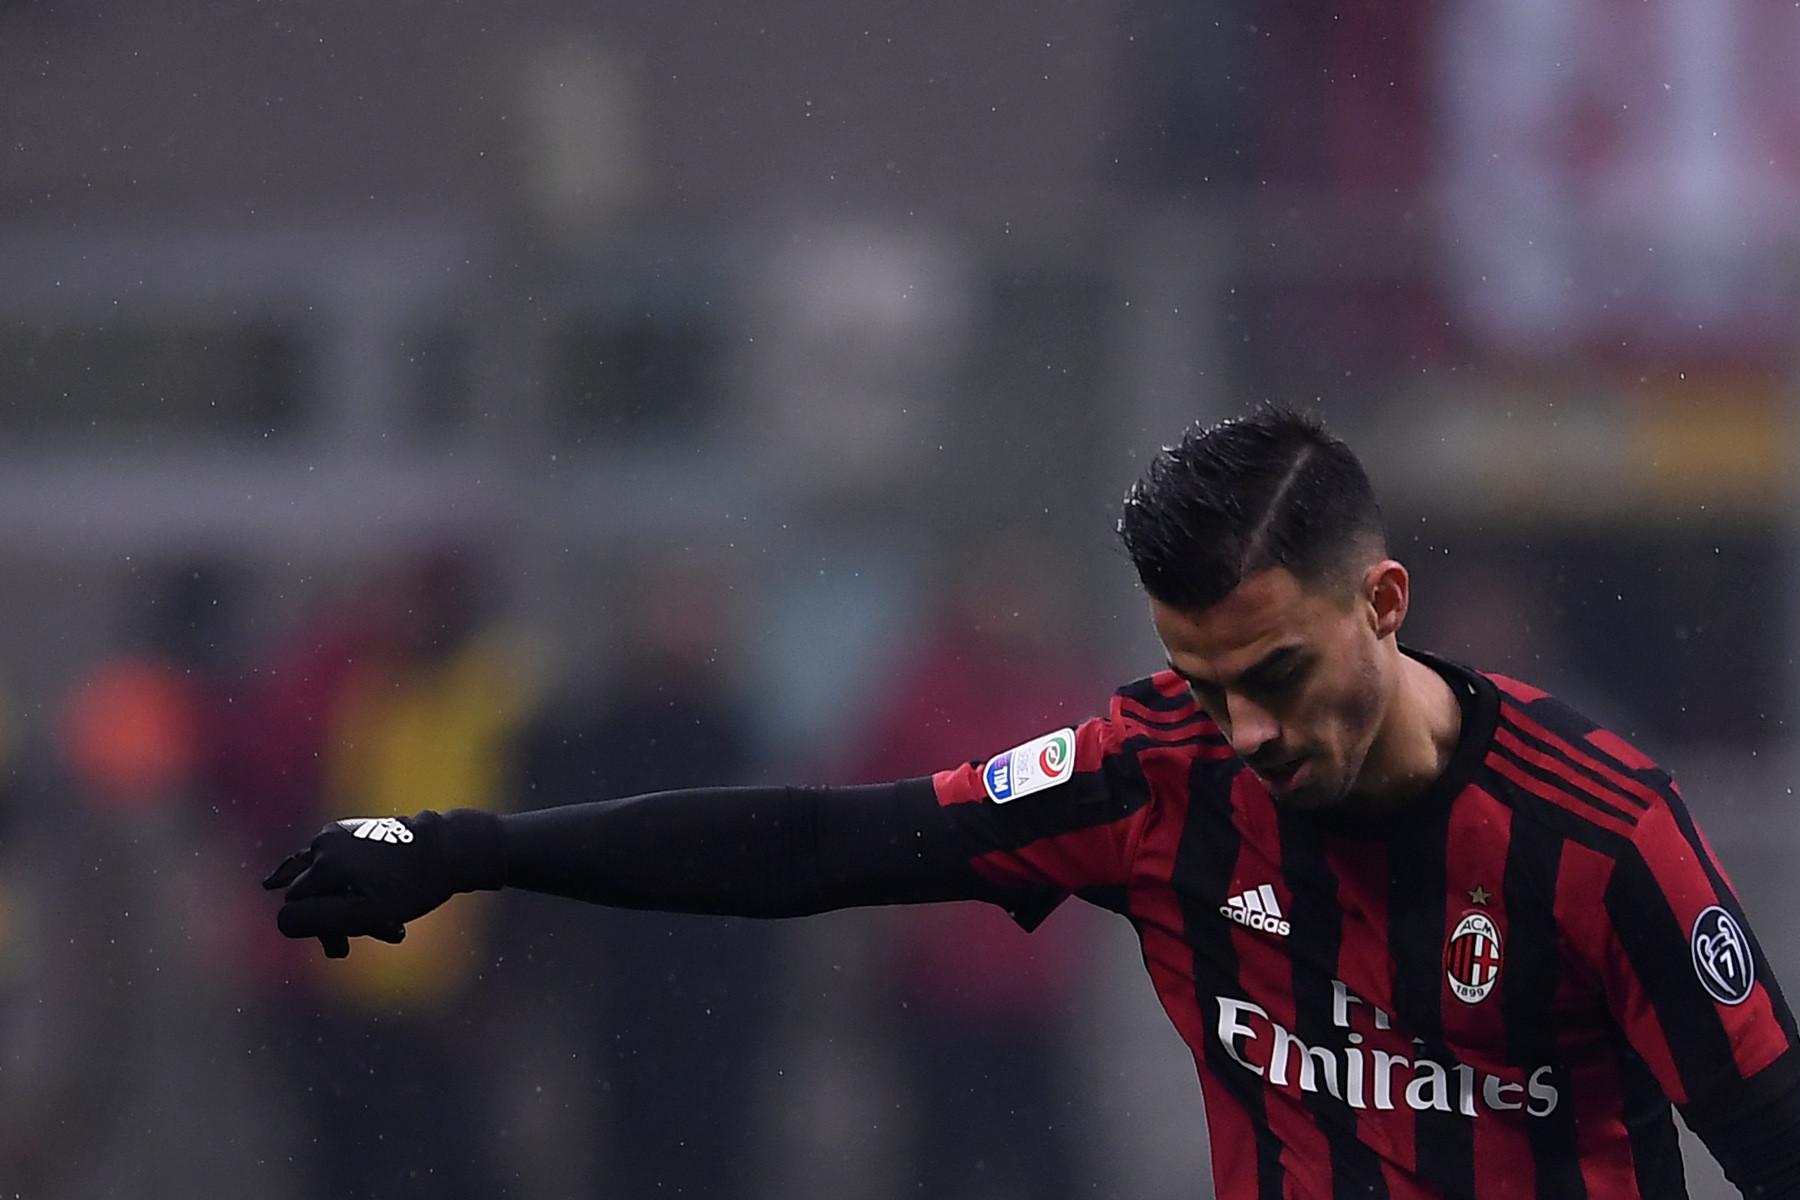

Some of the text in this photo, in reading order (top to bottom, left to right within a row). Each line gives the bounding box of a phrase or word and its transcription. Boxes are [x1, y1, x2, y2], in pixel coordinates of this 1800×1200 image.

[994, 766, 1009, 793] TIM
[1219, 904, 1291, 936] adidas
[1459, 918, 1494, 938] ACM
[1456, 984, 1484, 997] 1899
[1215, 996, 1559, 1117] Emirates
